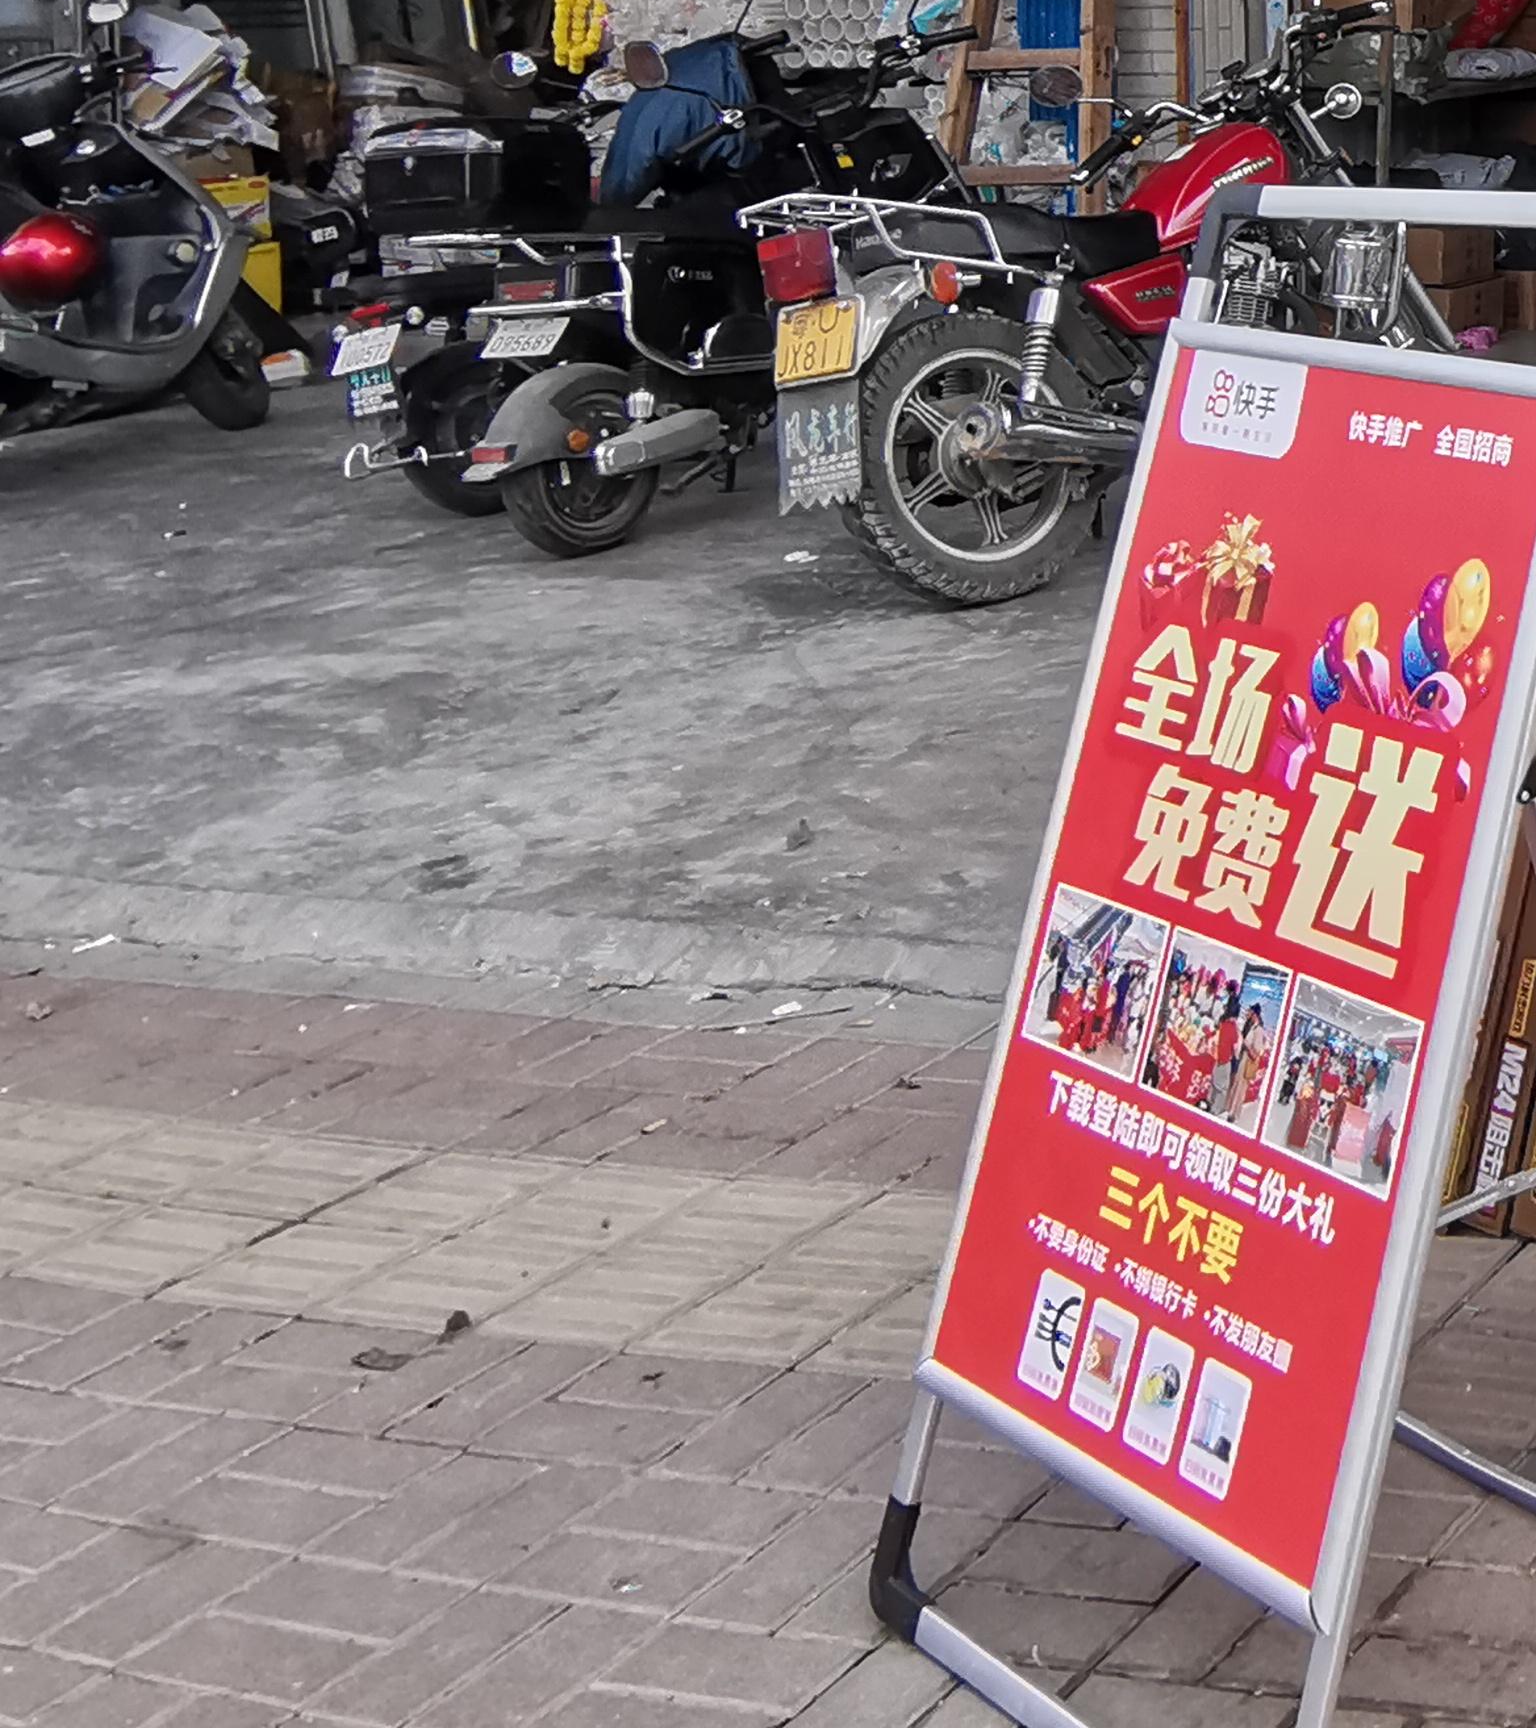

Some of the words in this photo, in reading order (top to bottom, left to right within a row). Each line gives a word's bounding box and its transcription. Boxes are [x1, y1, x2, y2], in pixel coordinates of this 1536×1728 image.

[1232, 380, 1279, 419] 快手
[1348, 410, 1423, 448] 快手推广
[1434, 425, 1513, 467] 全国招商
[1114, 623, 1280, 773] 全场
[1123, 764, 1289, 928] 免费
[1275, 723, 1444, 979] 送
[1047, 1070, 1336, 1245] 下载登陆即可领取三份大礼
[1098, 1165, 1244, 1284] 三个不要
